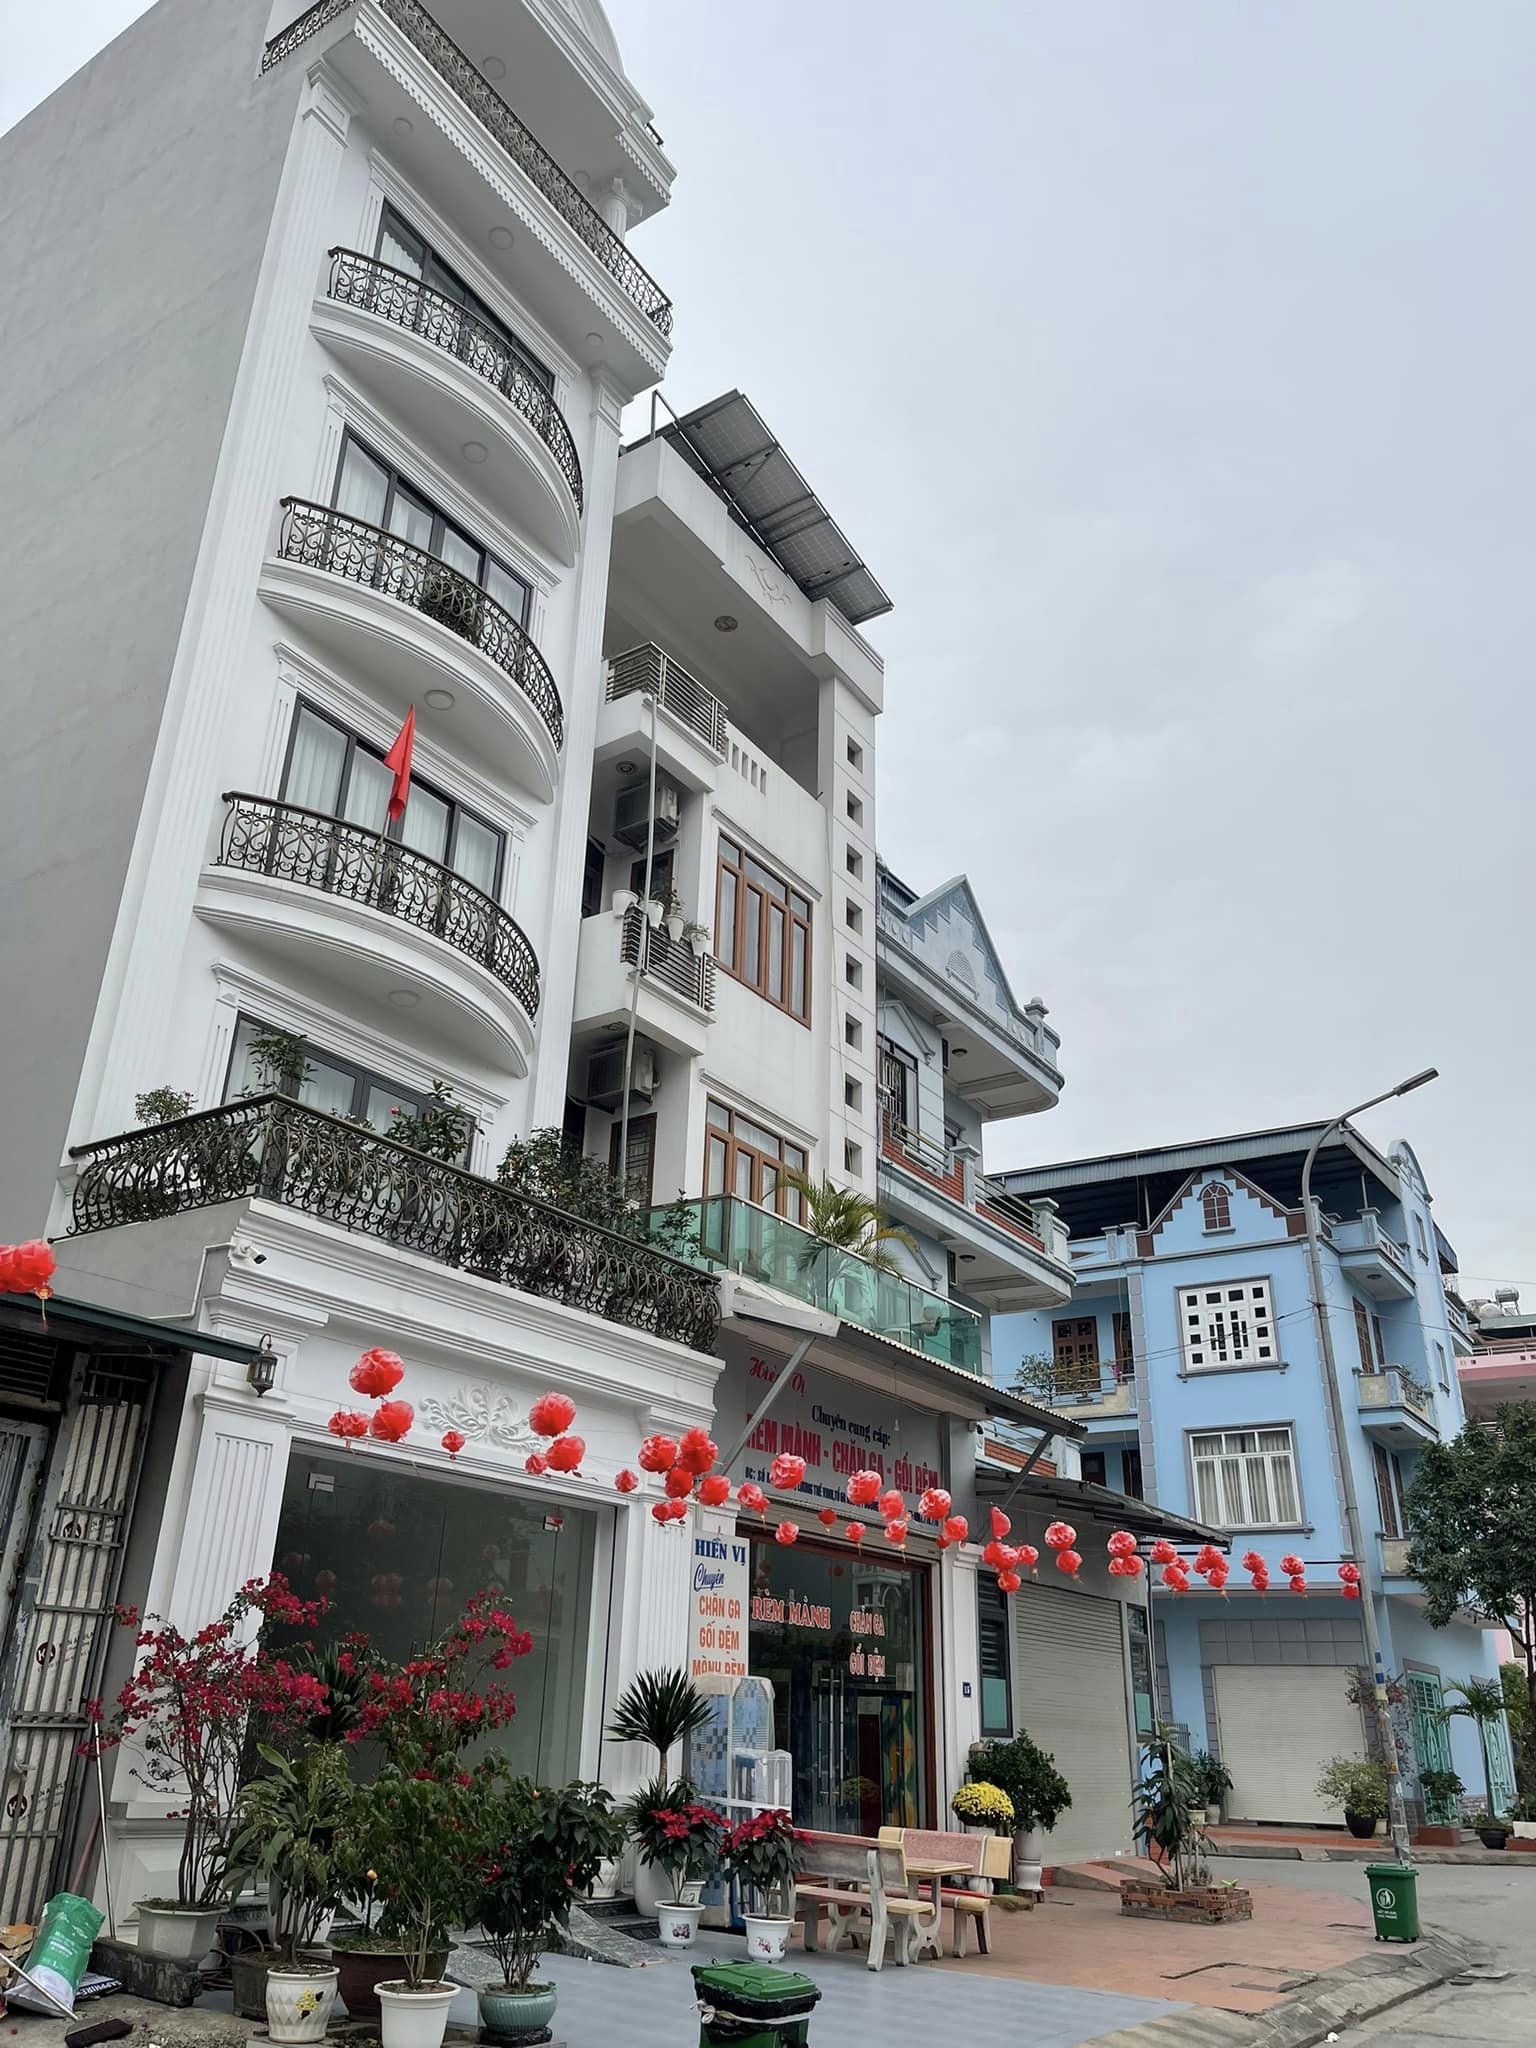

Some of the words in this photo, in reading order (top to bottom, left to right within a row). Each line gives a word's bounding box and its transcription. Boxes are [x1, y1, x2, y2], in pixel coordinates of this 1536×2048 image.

[811, 1405, 846, 1433] Chuyên
[848, 1421, 871, 1443] cung
[872, 1425, 891, 1450] cấp:
[781, 1421, 821, 1467] MÀNH
[832, 1439, 866, 1476] CHĂN
[895, 1451, 913, 1494] GỐI
[695, 1537, 727, 1560] HIỀN
[732, 1545, 747, 1566] VỊ
[693, 1562, 725, 1592] Chuyên
[699, 1593, 725, 1618] CHĂN
[728, 1599, 741, 1619] GA
[751, 1588, 785, 1623] RÈM
[788, 1595, 831, 1630] MÀNH
[849, 1605, 872, 1635] CHĂN
[872, 1613, 886, 1637] GA
[699, 1620, 715, 1649] GỐI
[718, 1625, 740, 1655] ĐỆM
[849, 1642, 865, 1676] GỐI
